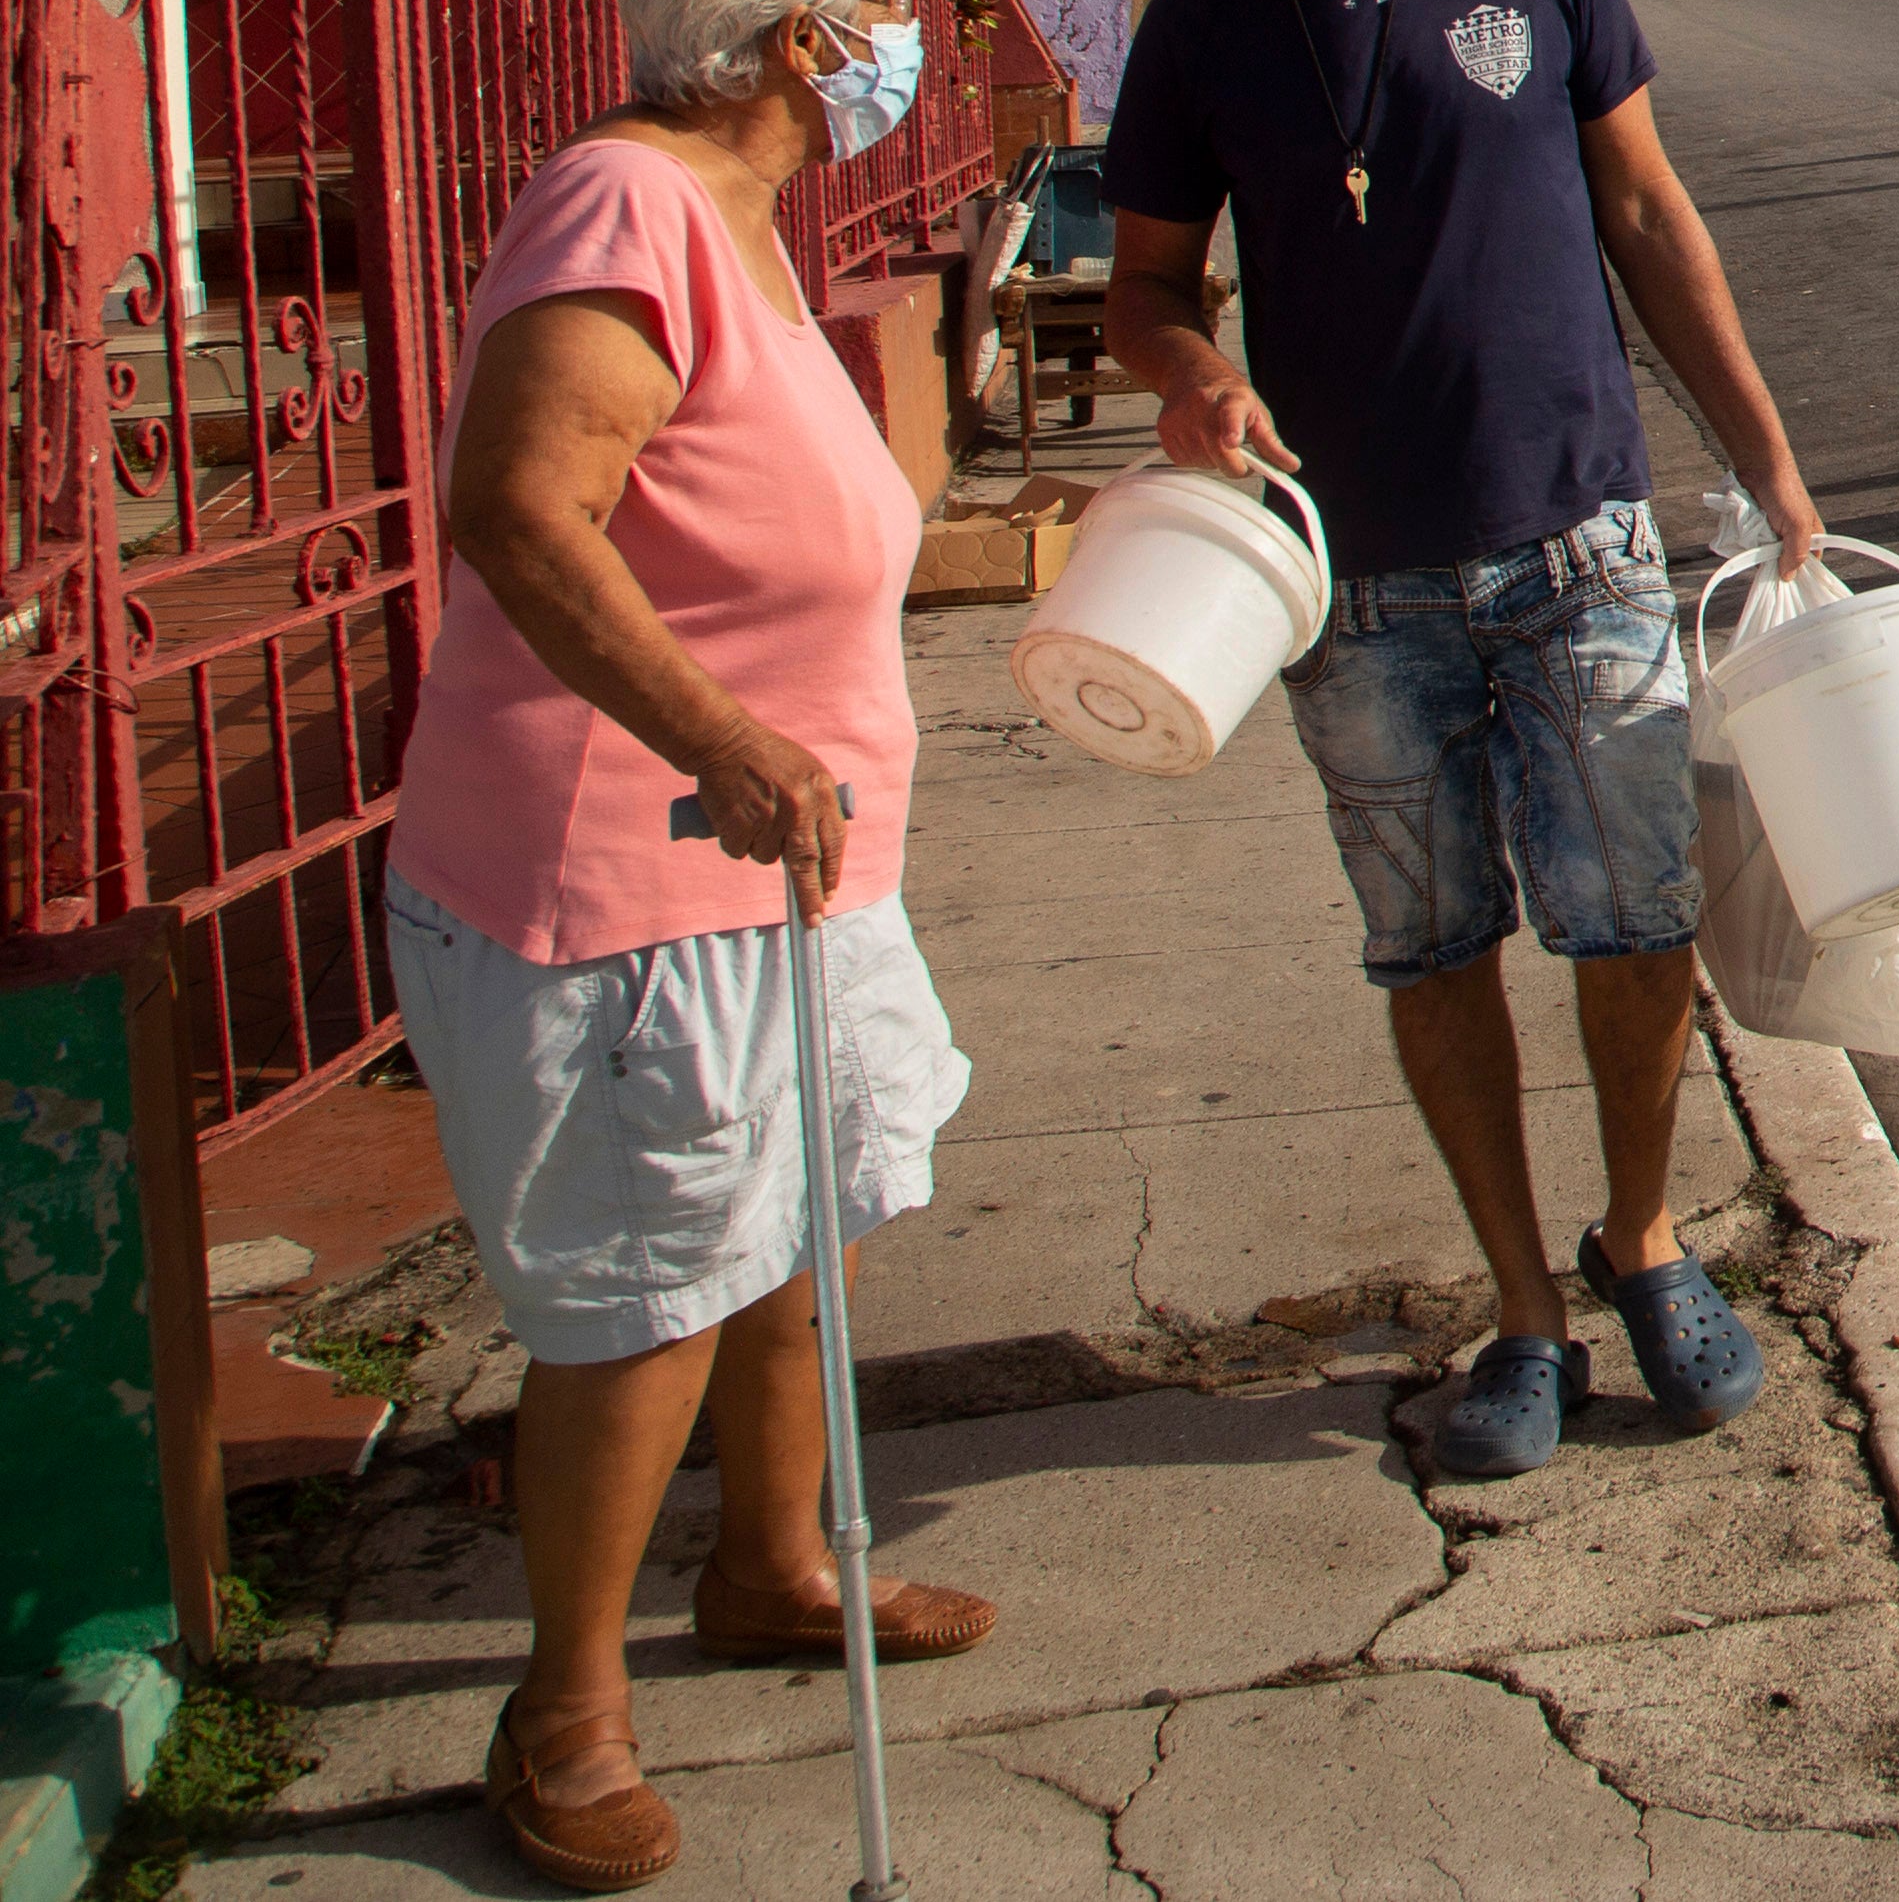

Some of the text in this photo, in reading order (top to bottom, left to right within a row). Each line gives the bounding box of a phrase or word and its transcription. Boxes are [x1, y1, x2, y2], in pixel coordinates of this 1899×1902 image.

[1455, 23, 1524, 47] METRO
[1461, 38, 1526, 55] HIGH SCHOOL
[1469, 59, 1528, 77] ALL STAR
